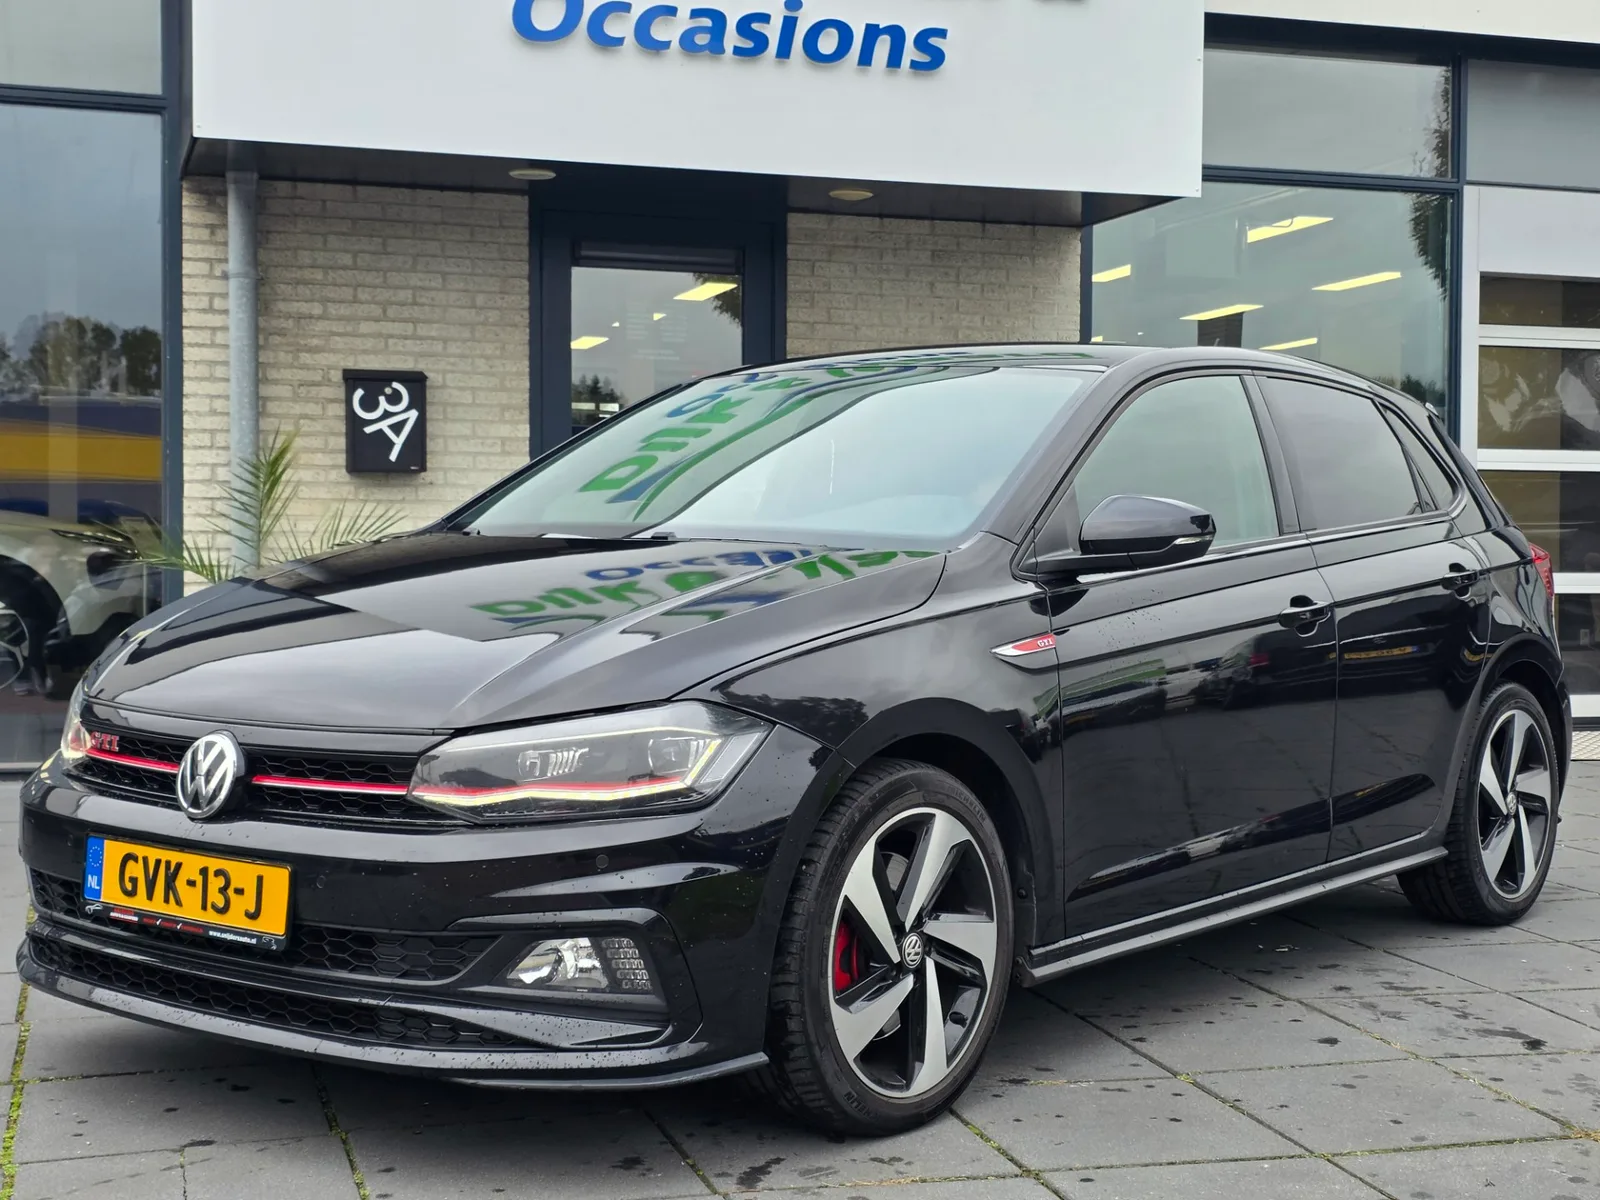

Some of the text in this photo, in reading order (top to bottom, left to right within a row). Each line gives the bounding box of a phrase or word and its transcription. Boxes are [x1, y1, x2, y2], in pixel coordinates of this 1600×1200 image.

[512, 0, 948, 72] Occasions
[352, 381, 419, 462] 3A
[1037, 638, 1053, 648] GTI
[90, 731, 120, 753] GTI
[87, 874, 100, 890] NL
[118, 852, 264, 921] GVK-13-J
